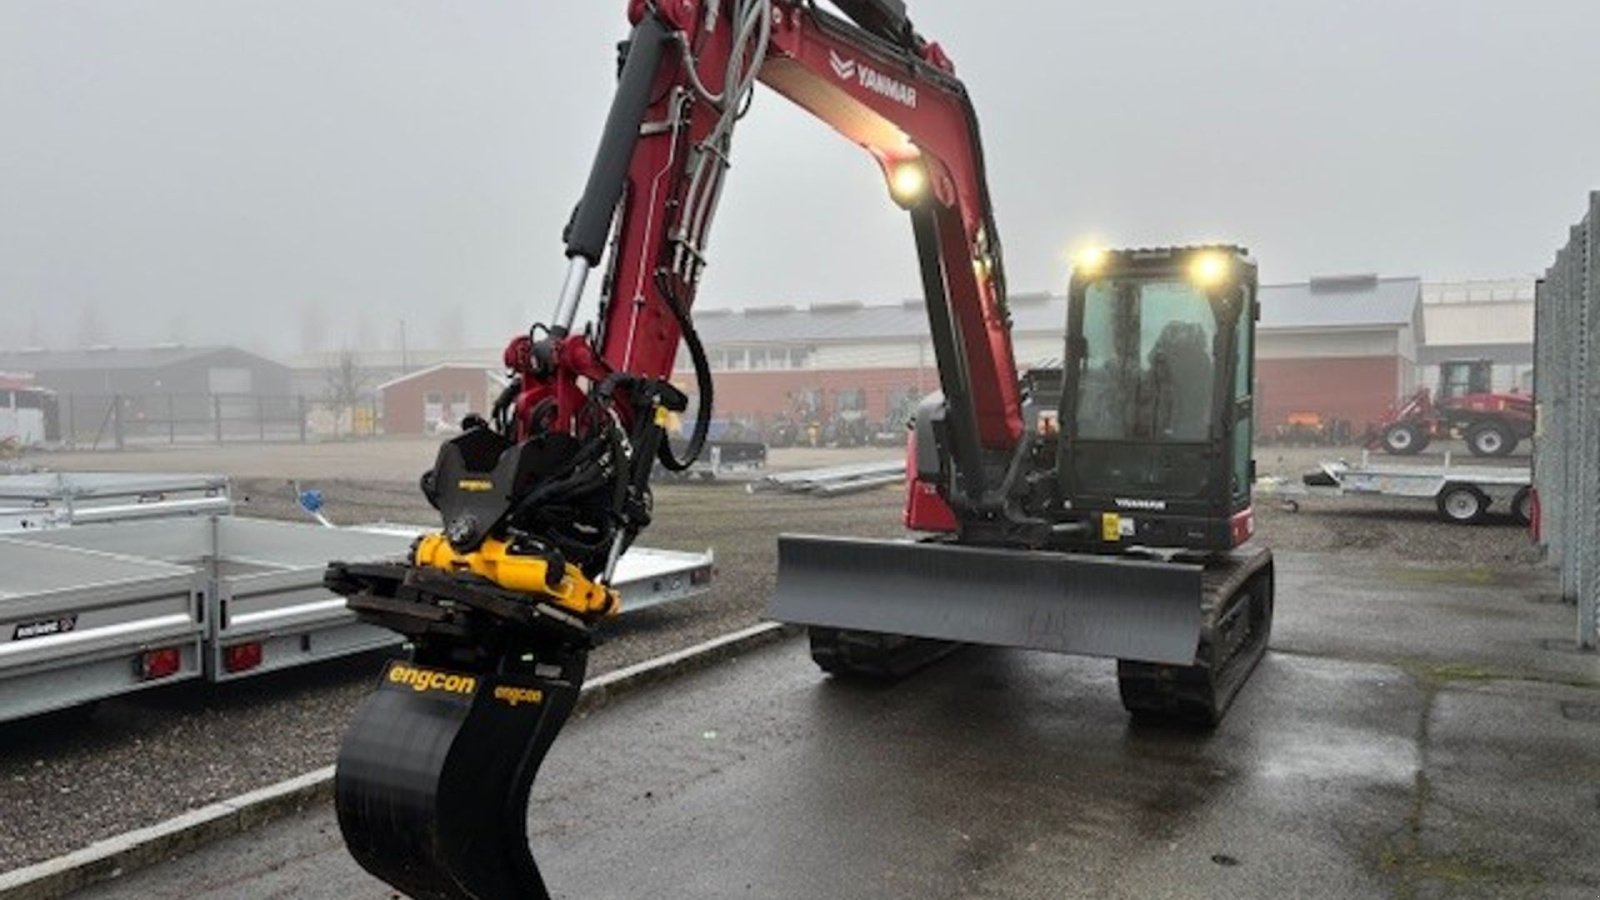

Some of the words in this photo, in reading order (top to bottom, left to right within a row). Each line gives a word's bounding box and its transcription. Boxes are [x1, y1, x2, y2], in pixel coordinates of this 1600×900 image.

[857, 63, 917, 108] YANMAR
[389, 666, 476, 694] engcon
[494, 686, 542, 706] engcon
